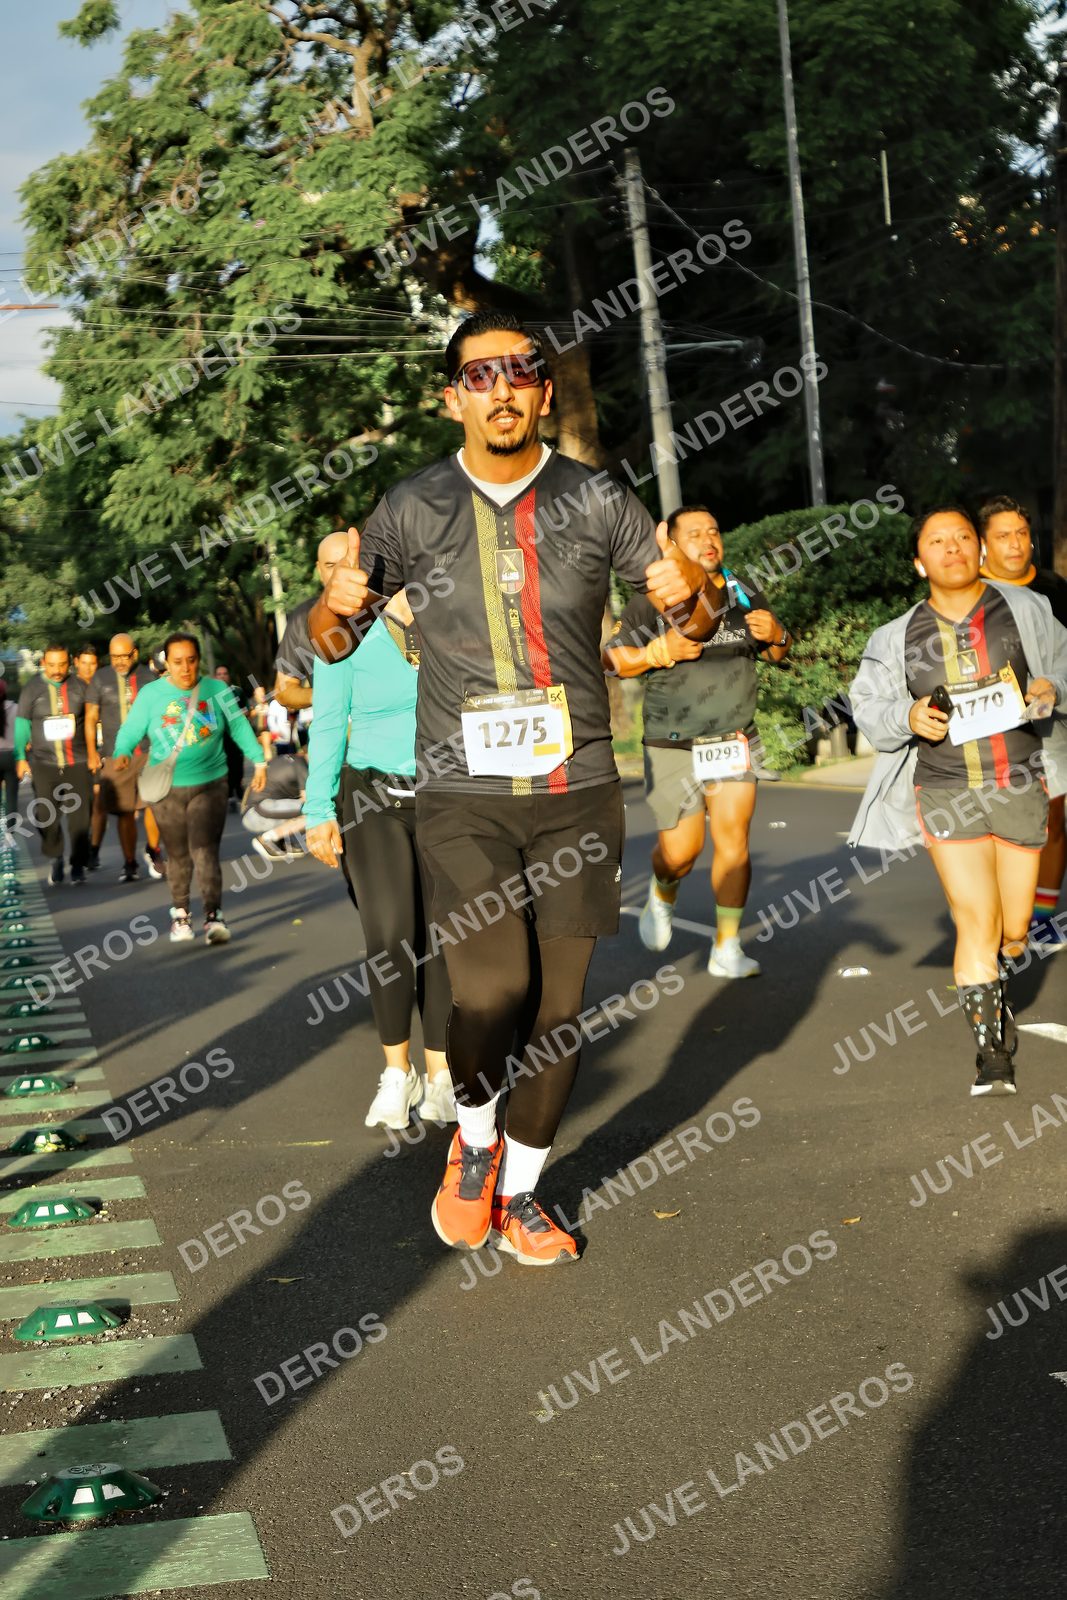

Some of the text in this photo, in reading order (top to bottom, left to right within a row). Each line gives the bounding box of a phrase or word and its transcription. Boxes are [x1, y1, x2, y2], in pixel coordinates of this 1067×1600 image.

[954, 691, 1004, 719] 1770
[478, 716, 547, 749] 1275
[697, 745, 740, 763] 10293
